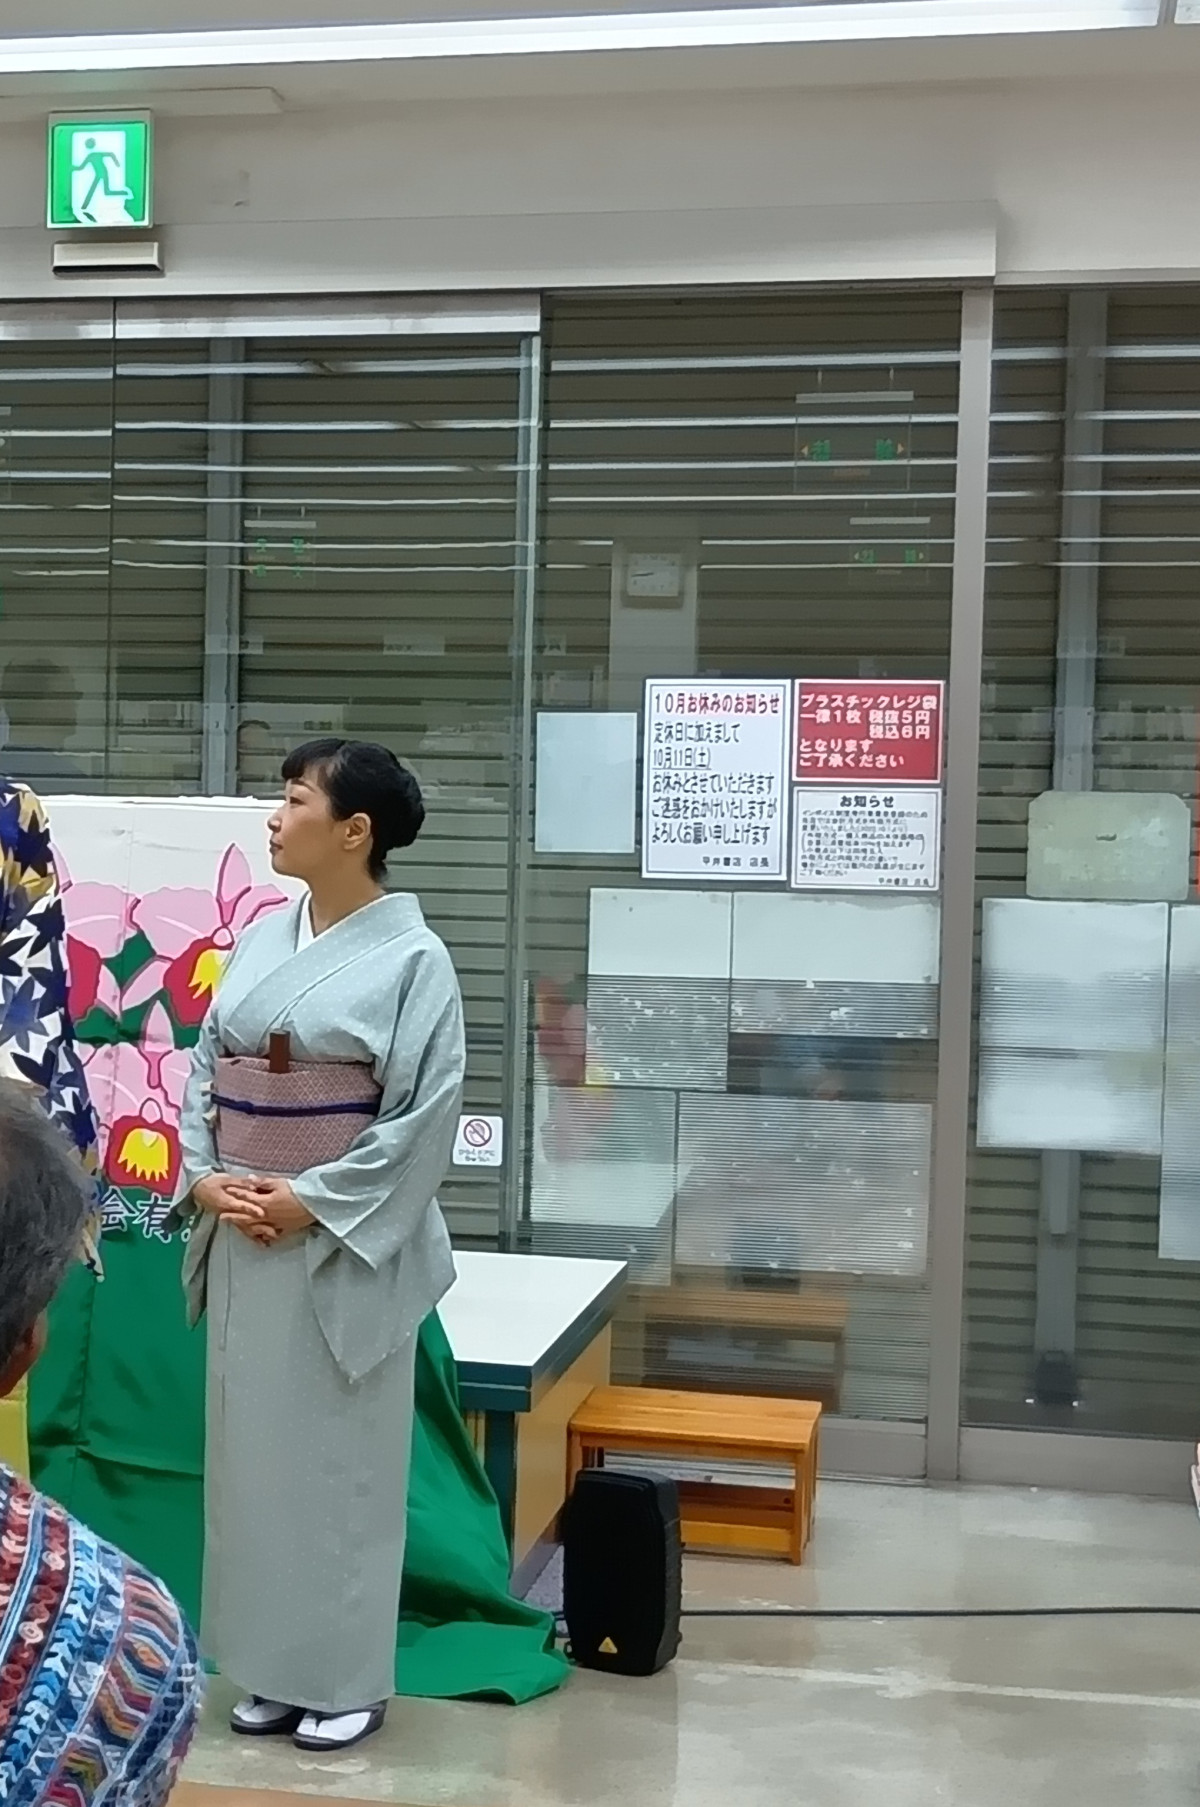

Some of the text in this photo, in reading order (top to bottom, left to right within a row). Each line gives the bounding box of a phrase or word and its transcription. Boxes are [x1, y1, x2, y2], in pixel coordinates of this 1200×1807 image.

[655, 692, 780, 714] 10月お休みのお知らせ
[800, 693, 938, 710] プラスチックレジ袋
[654, 721, 741, 744] 定休日に加えまして
[799, 738, 874, 753] となります
[799, 752, 905, 768] ご了承ください
[652, 772, 775, 795] お休みとさせていただきます
[652, 796, 778, 820] ご迷惑をおかけいたしますが
[840, 795, 895, 808] お知らせ
[652, 821, 771, 845] よろしくお願い申し上げます
